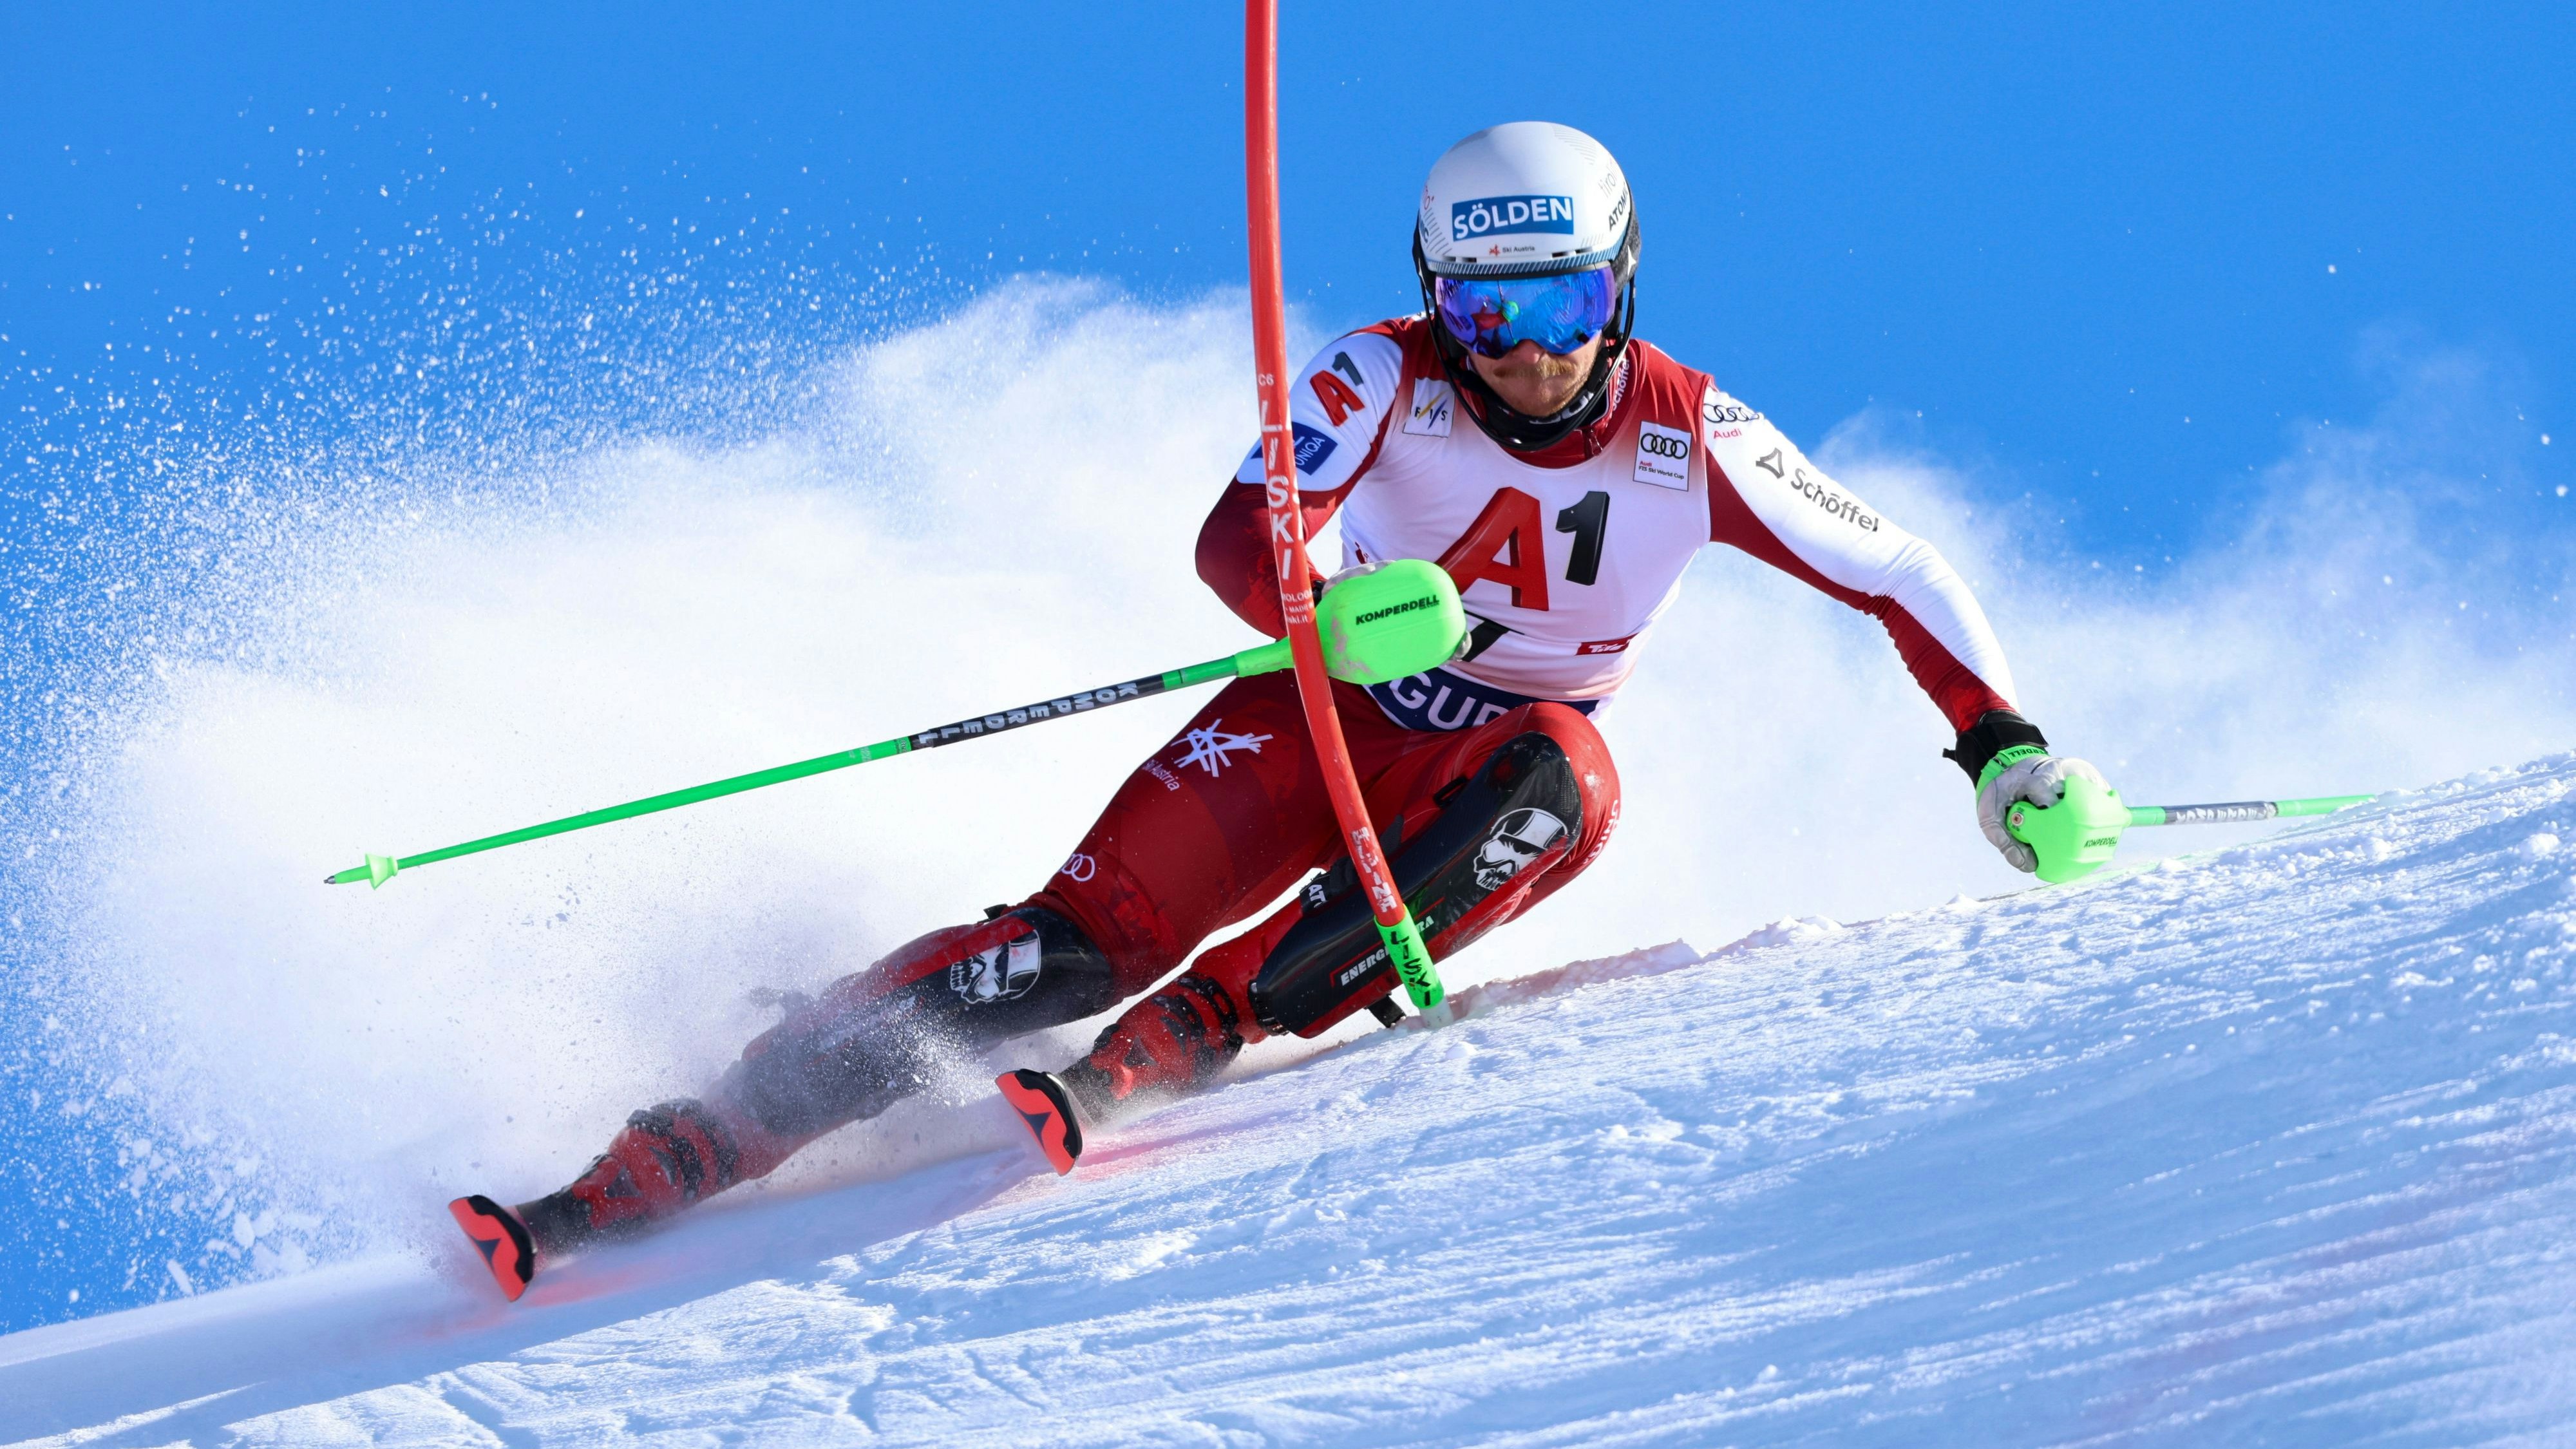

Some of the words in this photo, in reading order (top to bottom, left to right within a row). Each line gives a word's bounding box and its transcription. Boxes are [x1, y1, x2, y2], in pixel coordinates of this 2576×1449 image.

[1454, 198, 1572, 239] SÖLDEN
[1309, 351, 1365, 427] A1
[1414, 406, 1448, 421] FIS
[1713, 428, 1742, 439] Audi
[1294, 437, 1325, 466] UNIQA
[1260, 400, 1294, 580] LISKI
[1434, 486, 1610, 611] A1
[1356, 594, 1439, 625] KOMPERDELL
[918, 683, 1139, 744] KOMPERDELL
[1309, 884, 1327, 908] AT
[1391, 931, 1431, 1006] LISKI
